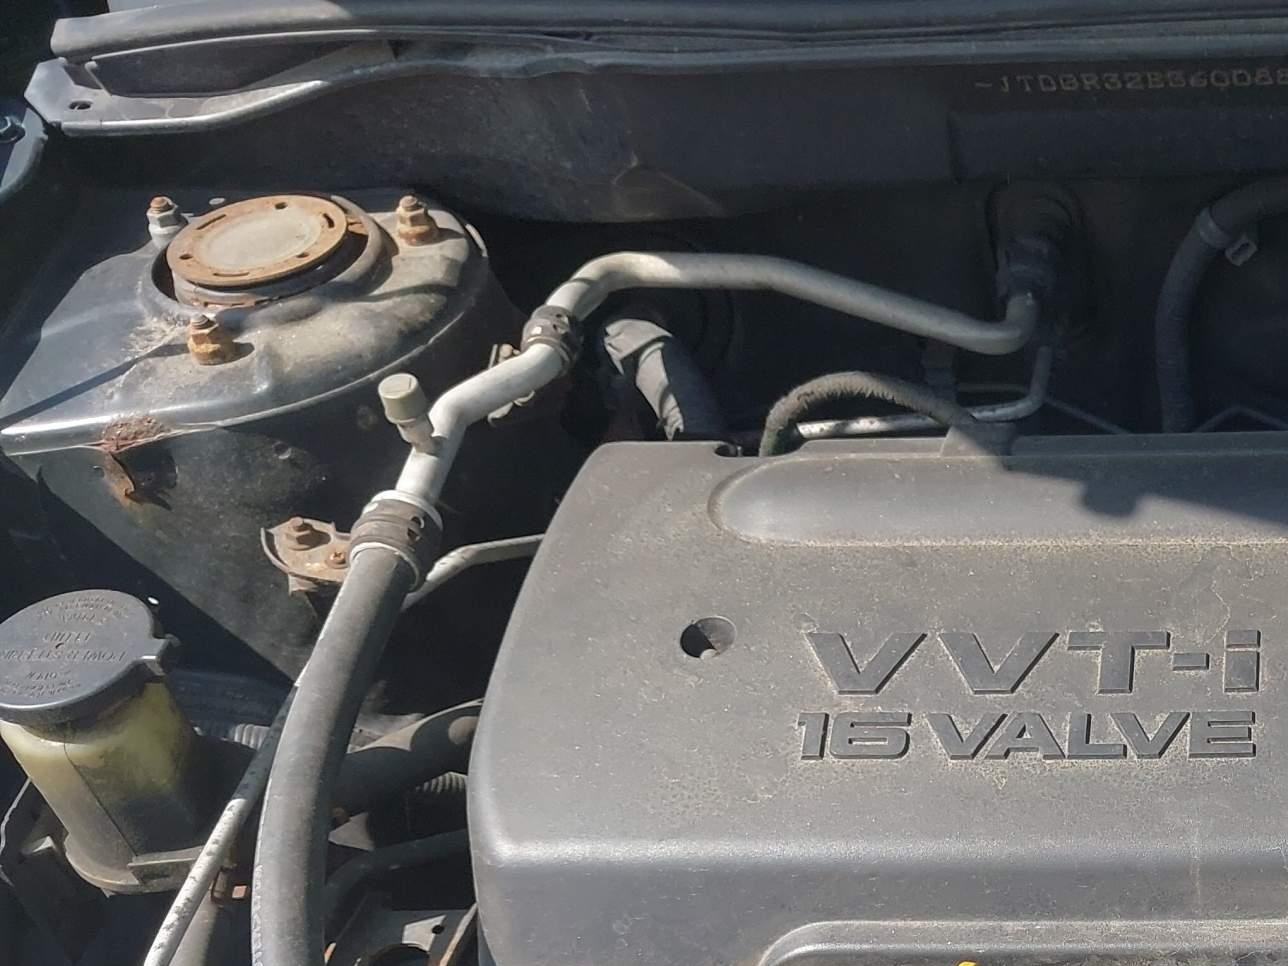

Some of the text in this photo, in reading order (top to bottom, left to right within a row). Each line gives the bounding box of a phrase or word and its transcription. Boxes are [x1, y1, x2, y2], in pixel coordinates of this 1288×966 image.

[804, 628, 1262, 696] VVT-i
[796, 710, 1257, 761] 16 VALVE
